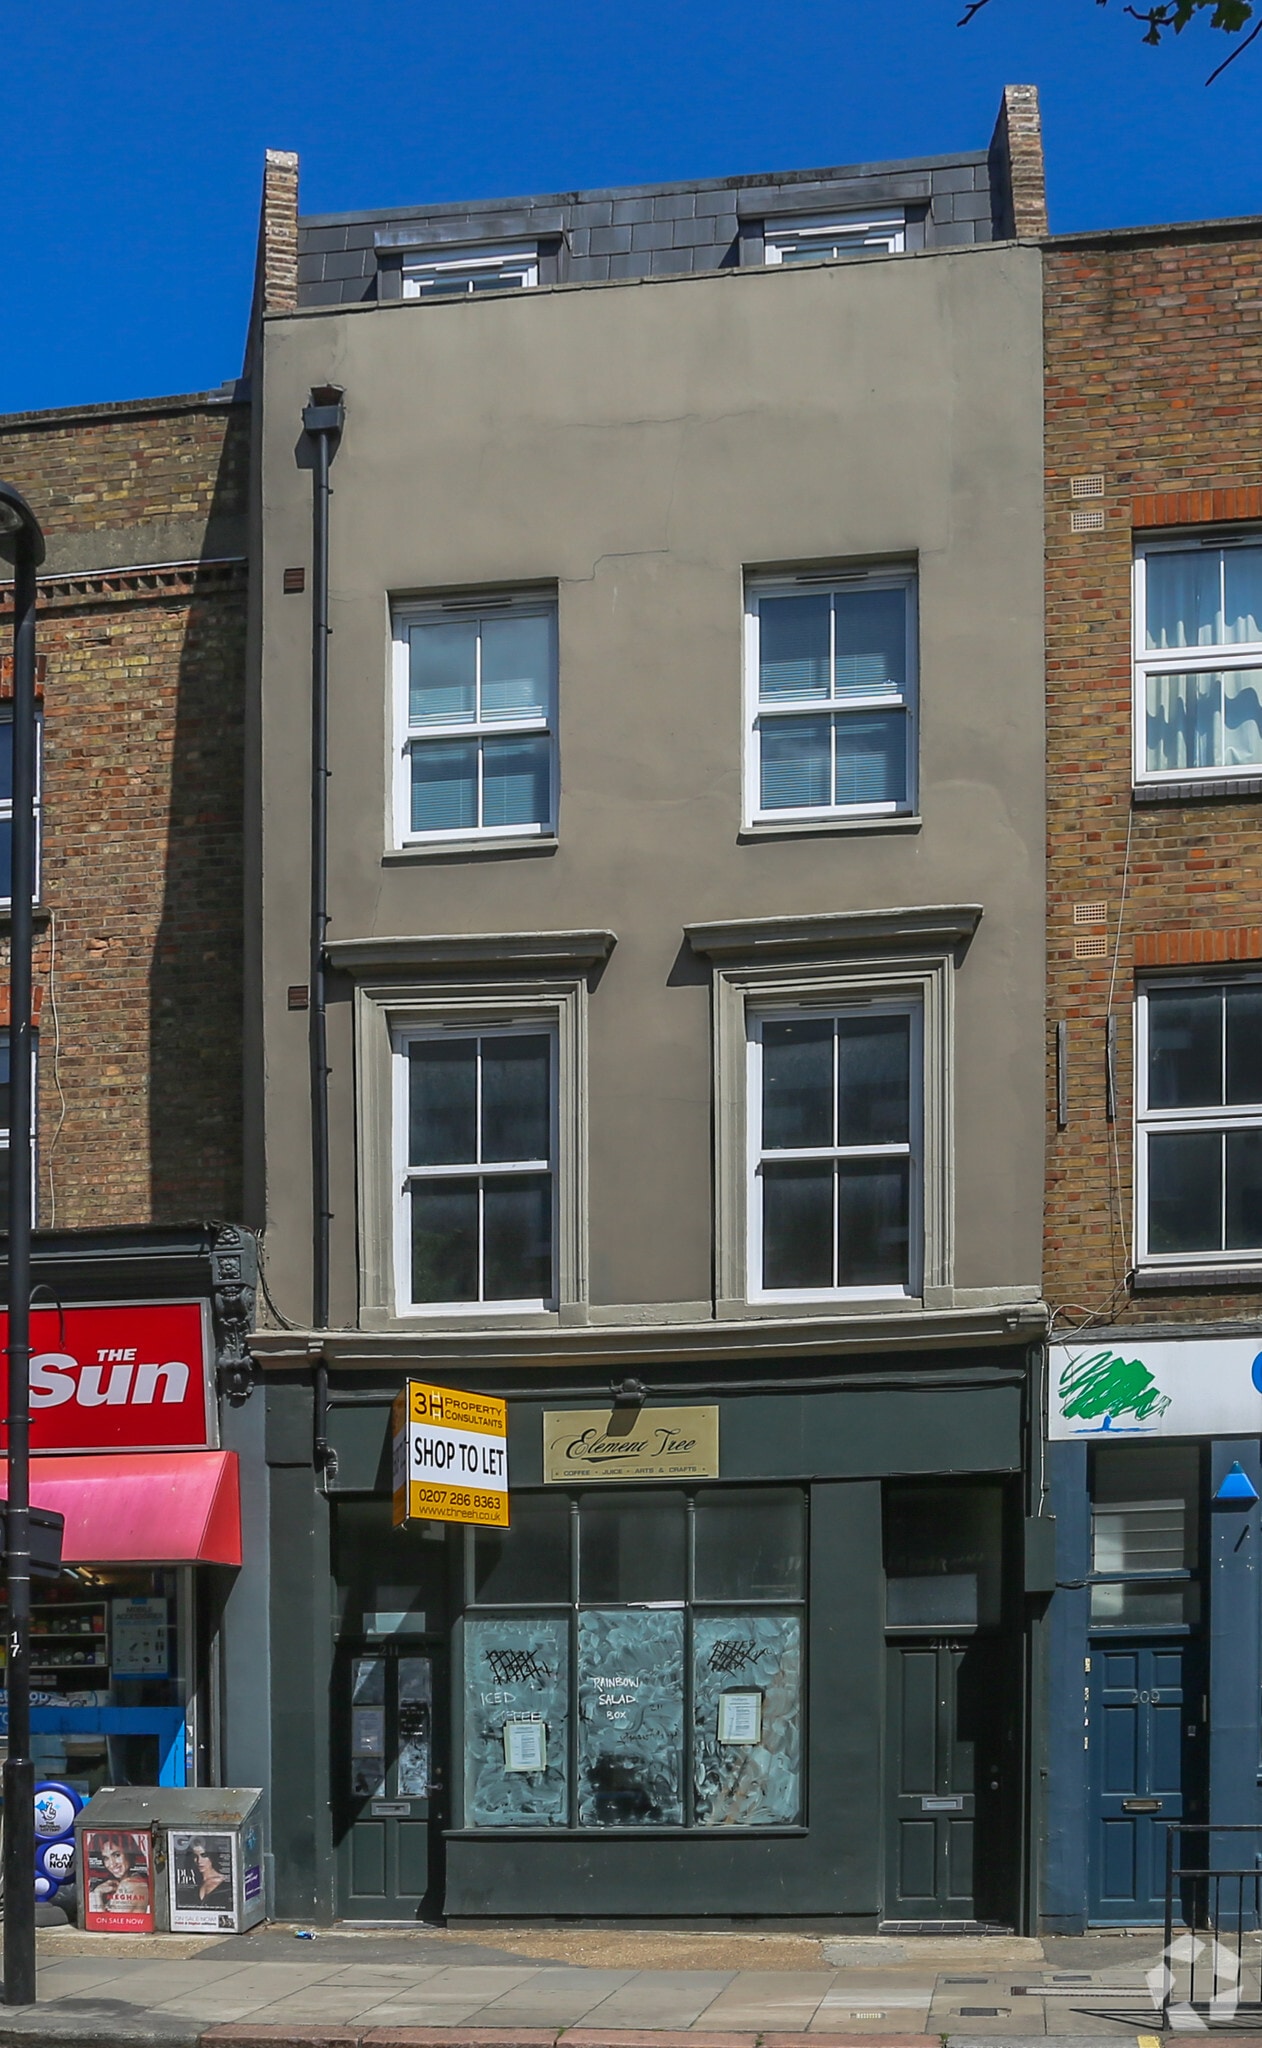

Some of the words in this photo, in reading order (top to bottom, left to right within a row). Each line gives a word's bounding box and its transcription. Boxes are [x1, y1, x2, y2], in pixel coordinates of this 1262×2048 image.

[97, 1348, 137, 1361] THE
[28, 1352, 190, 1408] Sun
[445, 1397, 502, 1416] PROPERTY
[445, 1410, 503, 1429] CONSULTANTS
[553, 1428, 649, 1459] Element
[651, 1428, 697, 1457] Tree
[414, 1437, 455, 1469] SHOP
[459, 1443, 478, 1472] TO
[482, 1447, 504, 1476] LET
[419, 1488, 447, 1503] 0207
[449, 1492, 471, 1506] 286
[473, 1495, 501, 1509] 8363
[419, 1506, 501, 1521] www.threeh.co.uk
[591, 1676, 639, 1692] RAINBOW
[480, 1692, 517, 1706] ICED
[598, 1694, 637, 1705] SALAD
[1131, 1690, 1160, 1703] 209
[606, 1710, 627, 1720] BOX
[49, 1853, 74, 1861] PLAY
[49, 1861, 73, 1869] NOW
